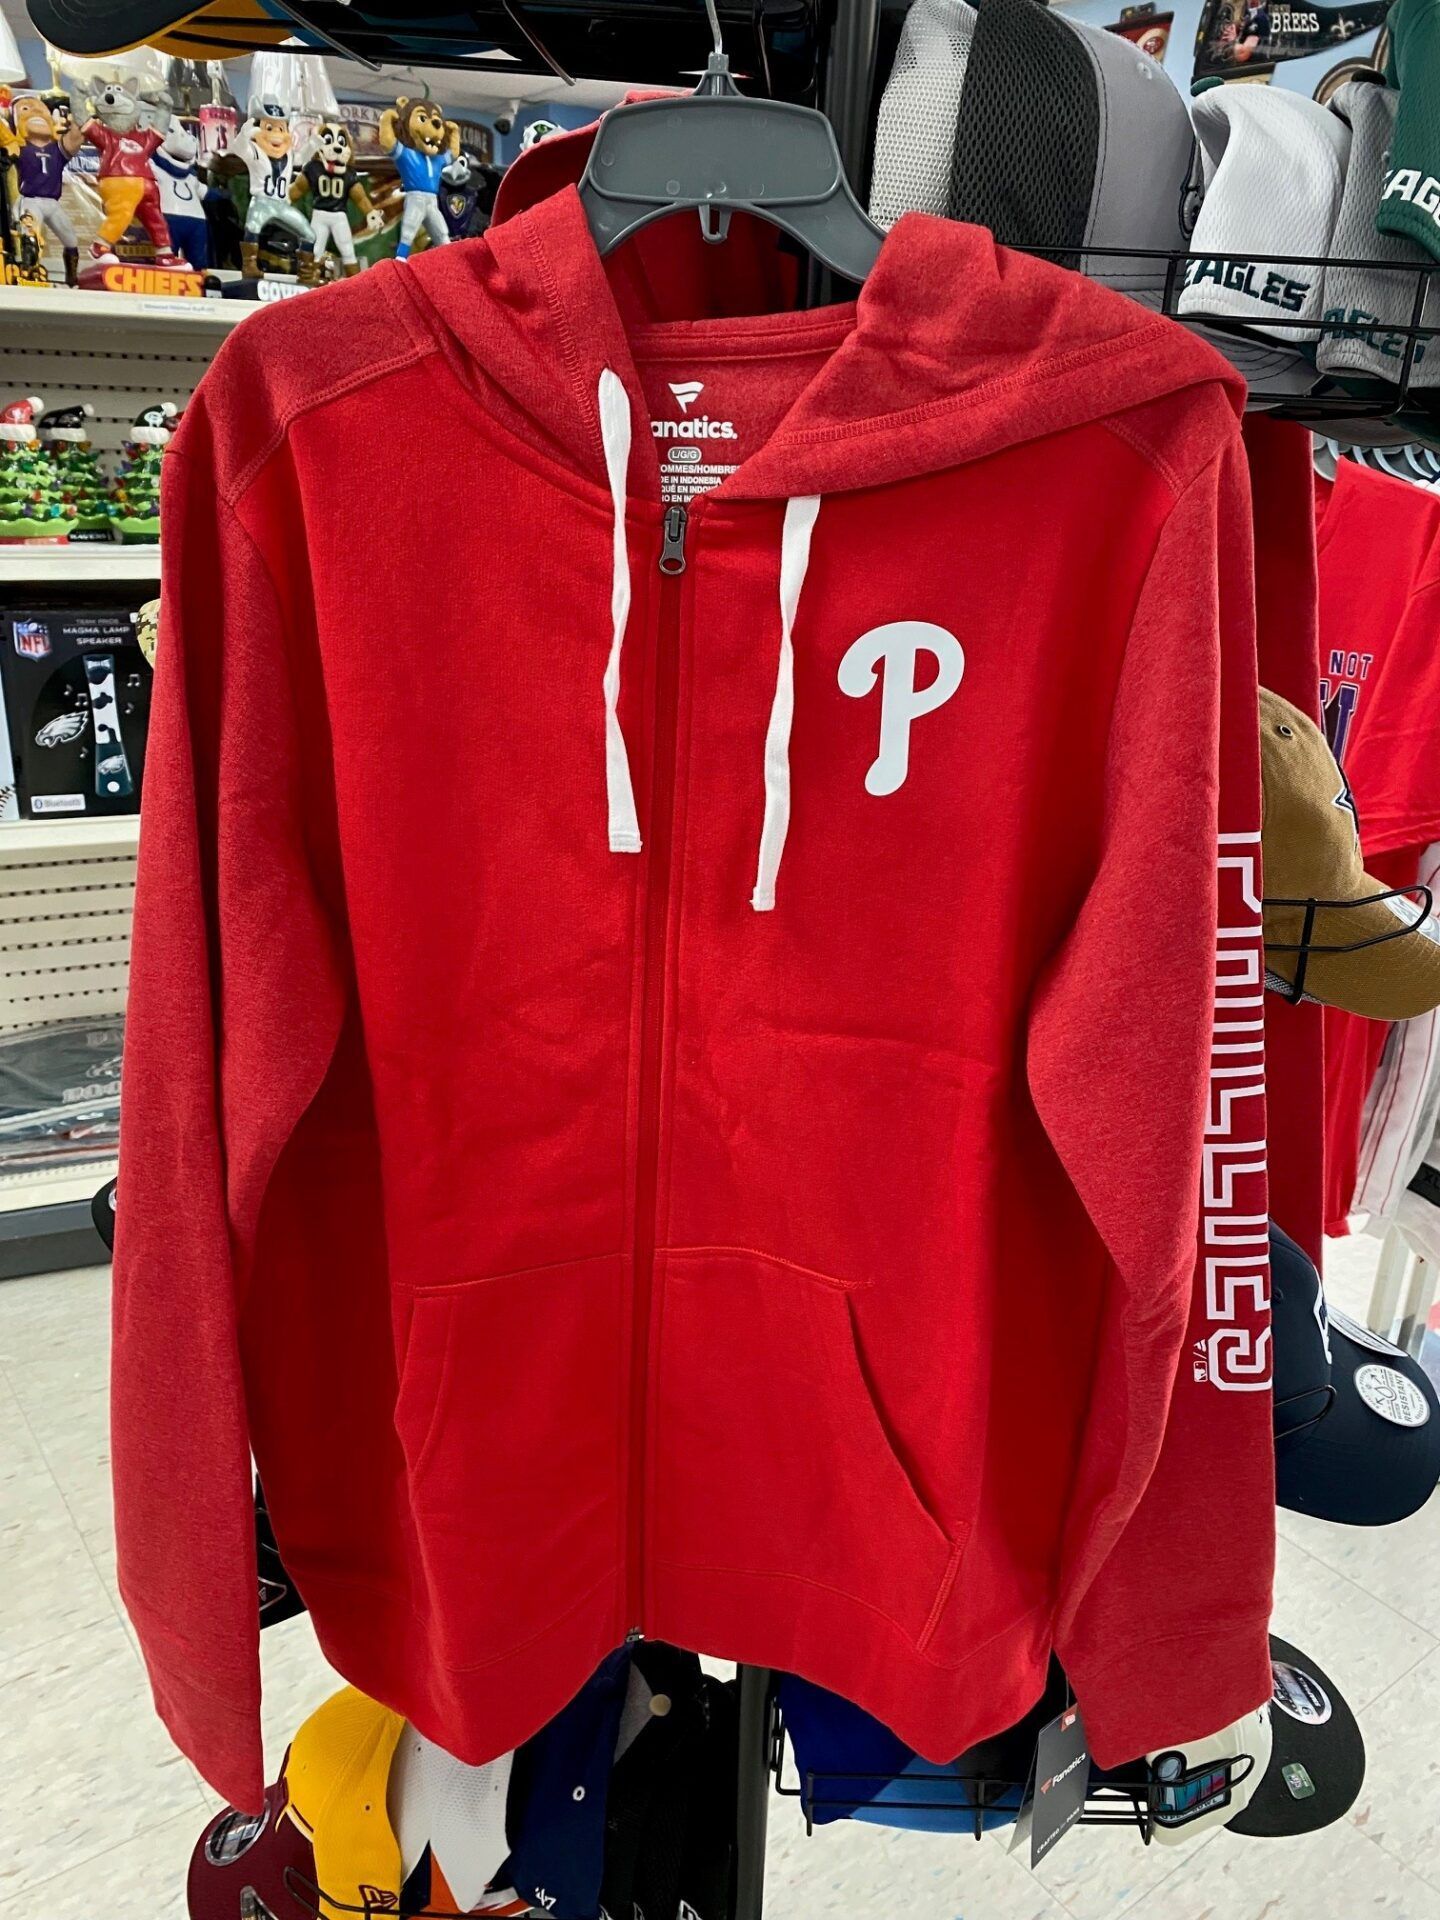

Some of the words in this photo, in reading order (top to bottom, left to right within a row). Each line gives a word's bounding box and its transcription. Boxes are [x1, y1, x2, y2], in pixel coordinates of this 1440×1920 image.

[1270, 12, 1320, 33] BREES
[340, 106, 370, 121] ORK
[318, 175, 344, 198] 00
[103, 265, 203, 297] CHIEFS
[1183, 259, 1311, 312] AGLES
[650, 415, 738, 440] anatics.
[671, 450, 697, 459] L/G/G
[660, 464, 741, 474] OMMES/HOMBRE
[670, 476, 678, 484] IN
[680, 476, 723, 485] INDONESIA
[677, 485, 688, 494] EN
[671, 494, 683, 502] EN
[62, 626, 100, 635] MAGMA
[103, 625, 130, 634] LAMP
[75, 636, 122, 645] SPEAKER
[1328, 649, 1373, 680] NOT
[837, 620, 965, 797] P
[1394, 1374, 1413, 1423] RESISTANT
[1051, 1752, 1087, 1788] Fanatics
[1036, 1828, 1060, 1854] CRAFTED
